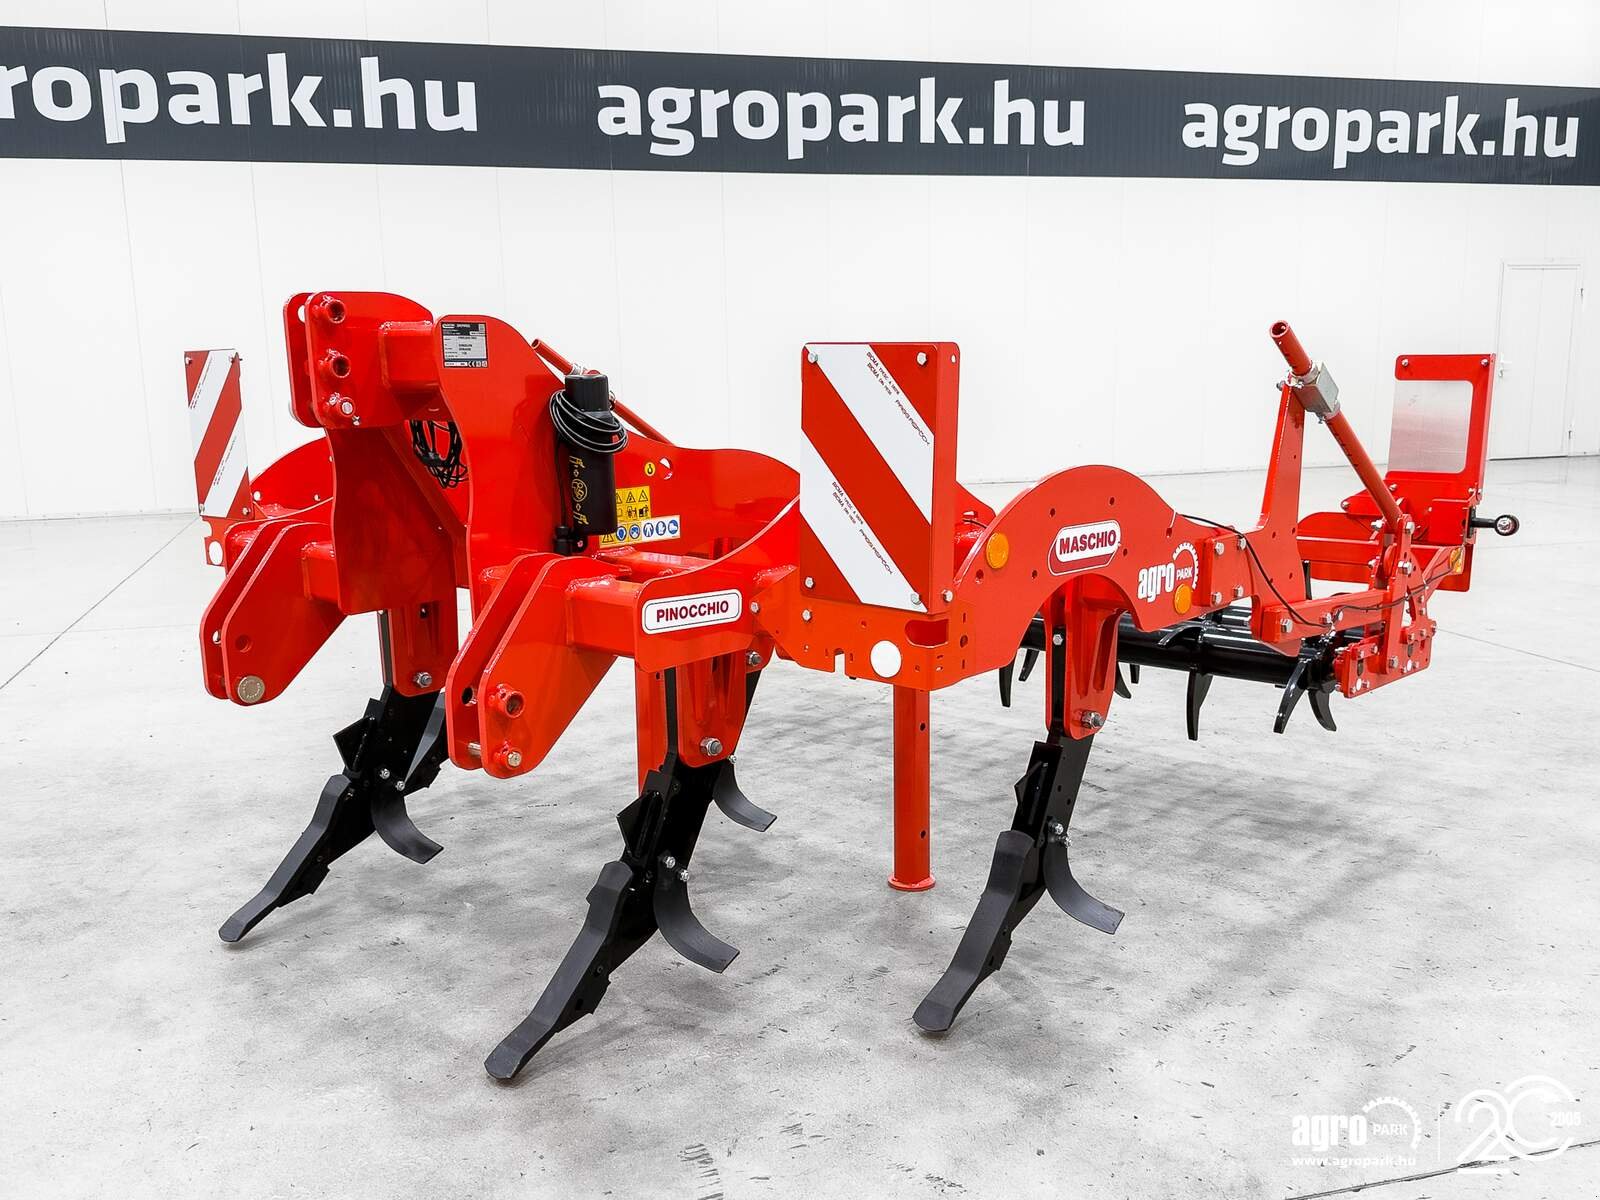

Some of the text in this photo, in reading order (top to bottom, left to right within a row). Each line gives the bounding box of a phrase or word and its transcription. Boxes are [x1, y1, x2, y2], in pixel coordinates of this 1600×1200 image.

[597, 77, 1085, 160] agropark.hu
[1182, 95, 1580, 169] agropark.hu
[1059, 529, 1117, 555] MASCHIO
[1137, 562, 1193, 603] agro PARK
[656, 600, 729, 622] PINOCCHIO
